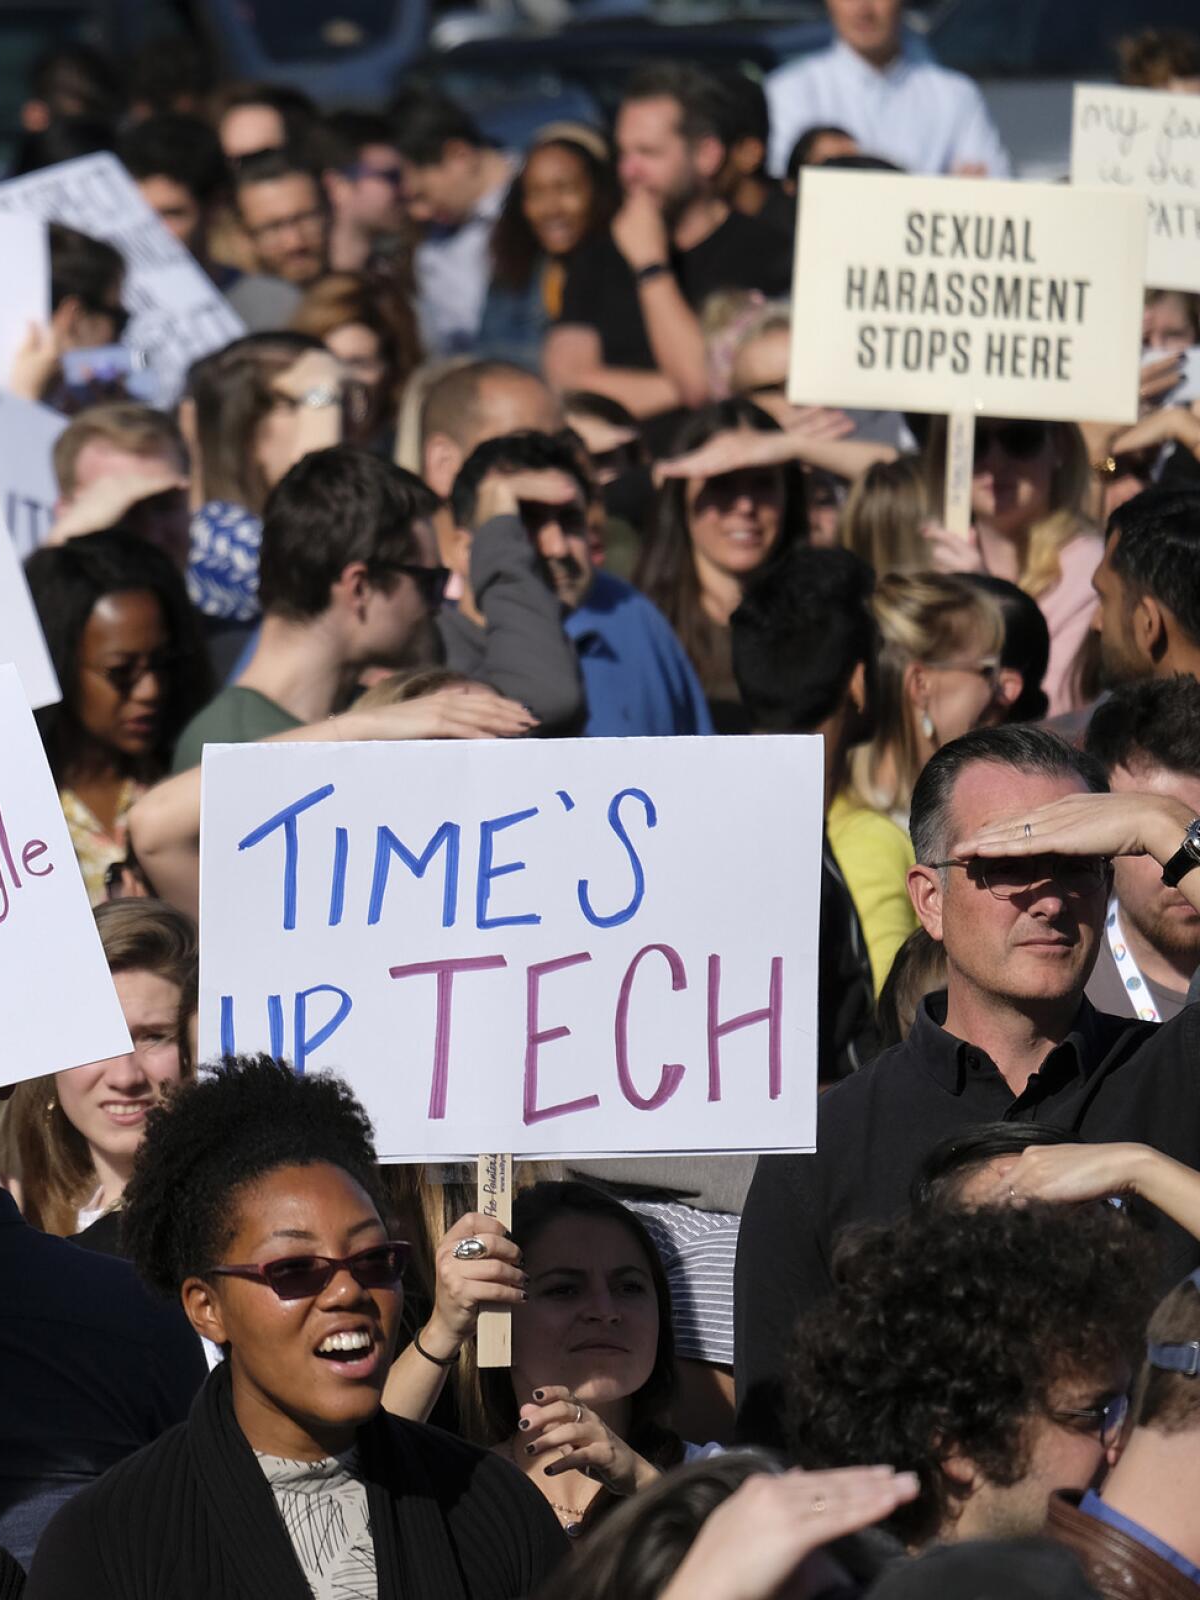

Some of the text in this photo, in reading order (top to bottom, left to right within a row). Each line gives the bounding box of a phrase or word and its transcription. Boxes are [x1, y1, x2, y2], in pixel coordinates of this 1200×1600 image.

[904, 210, 1037, 263] SEXUAL
[845, 265, 1092, 325] HARASSMENT
[857, 324, 1073, 381] STOPS HERE
[238, 783, 658, 931] TIME'S
[389, 942, 783, 1126] TECH
